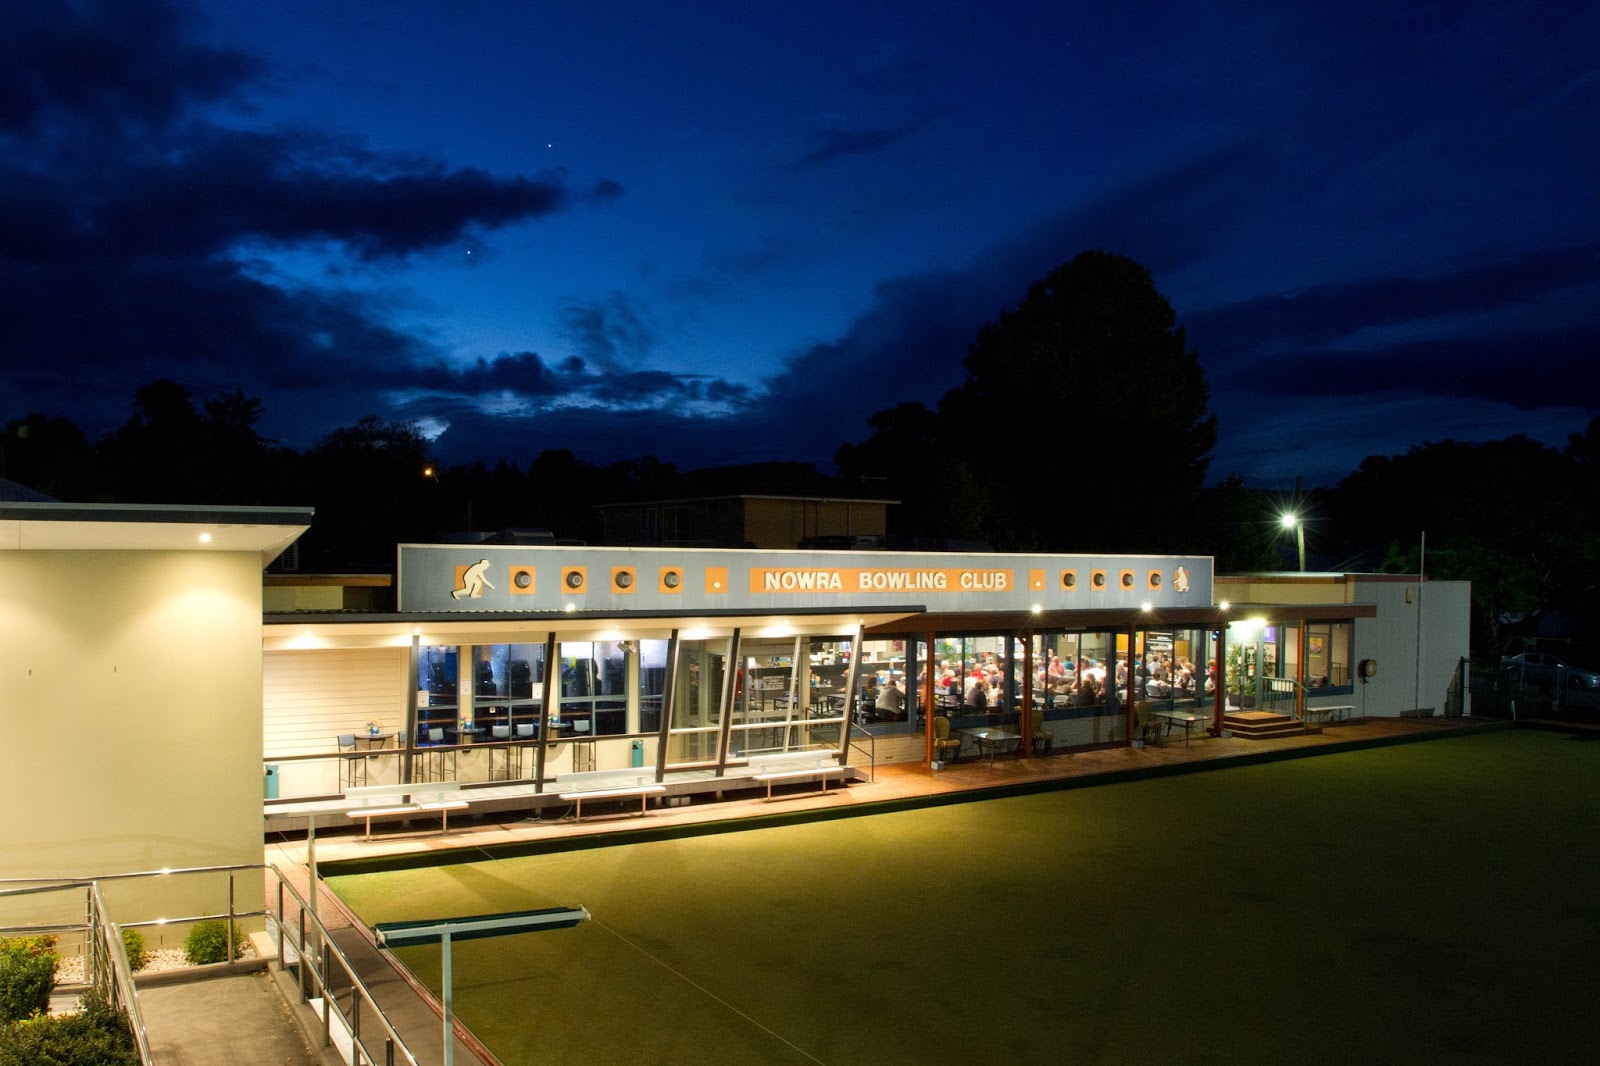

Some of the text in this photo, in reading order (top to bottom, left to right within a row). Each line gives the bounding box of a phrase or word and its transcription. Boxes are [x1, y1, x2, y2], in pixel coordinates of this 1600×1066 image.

[765, 571, 1007, 590] NOWRA BOWLING CLUB
